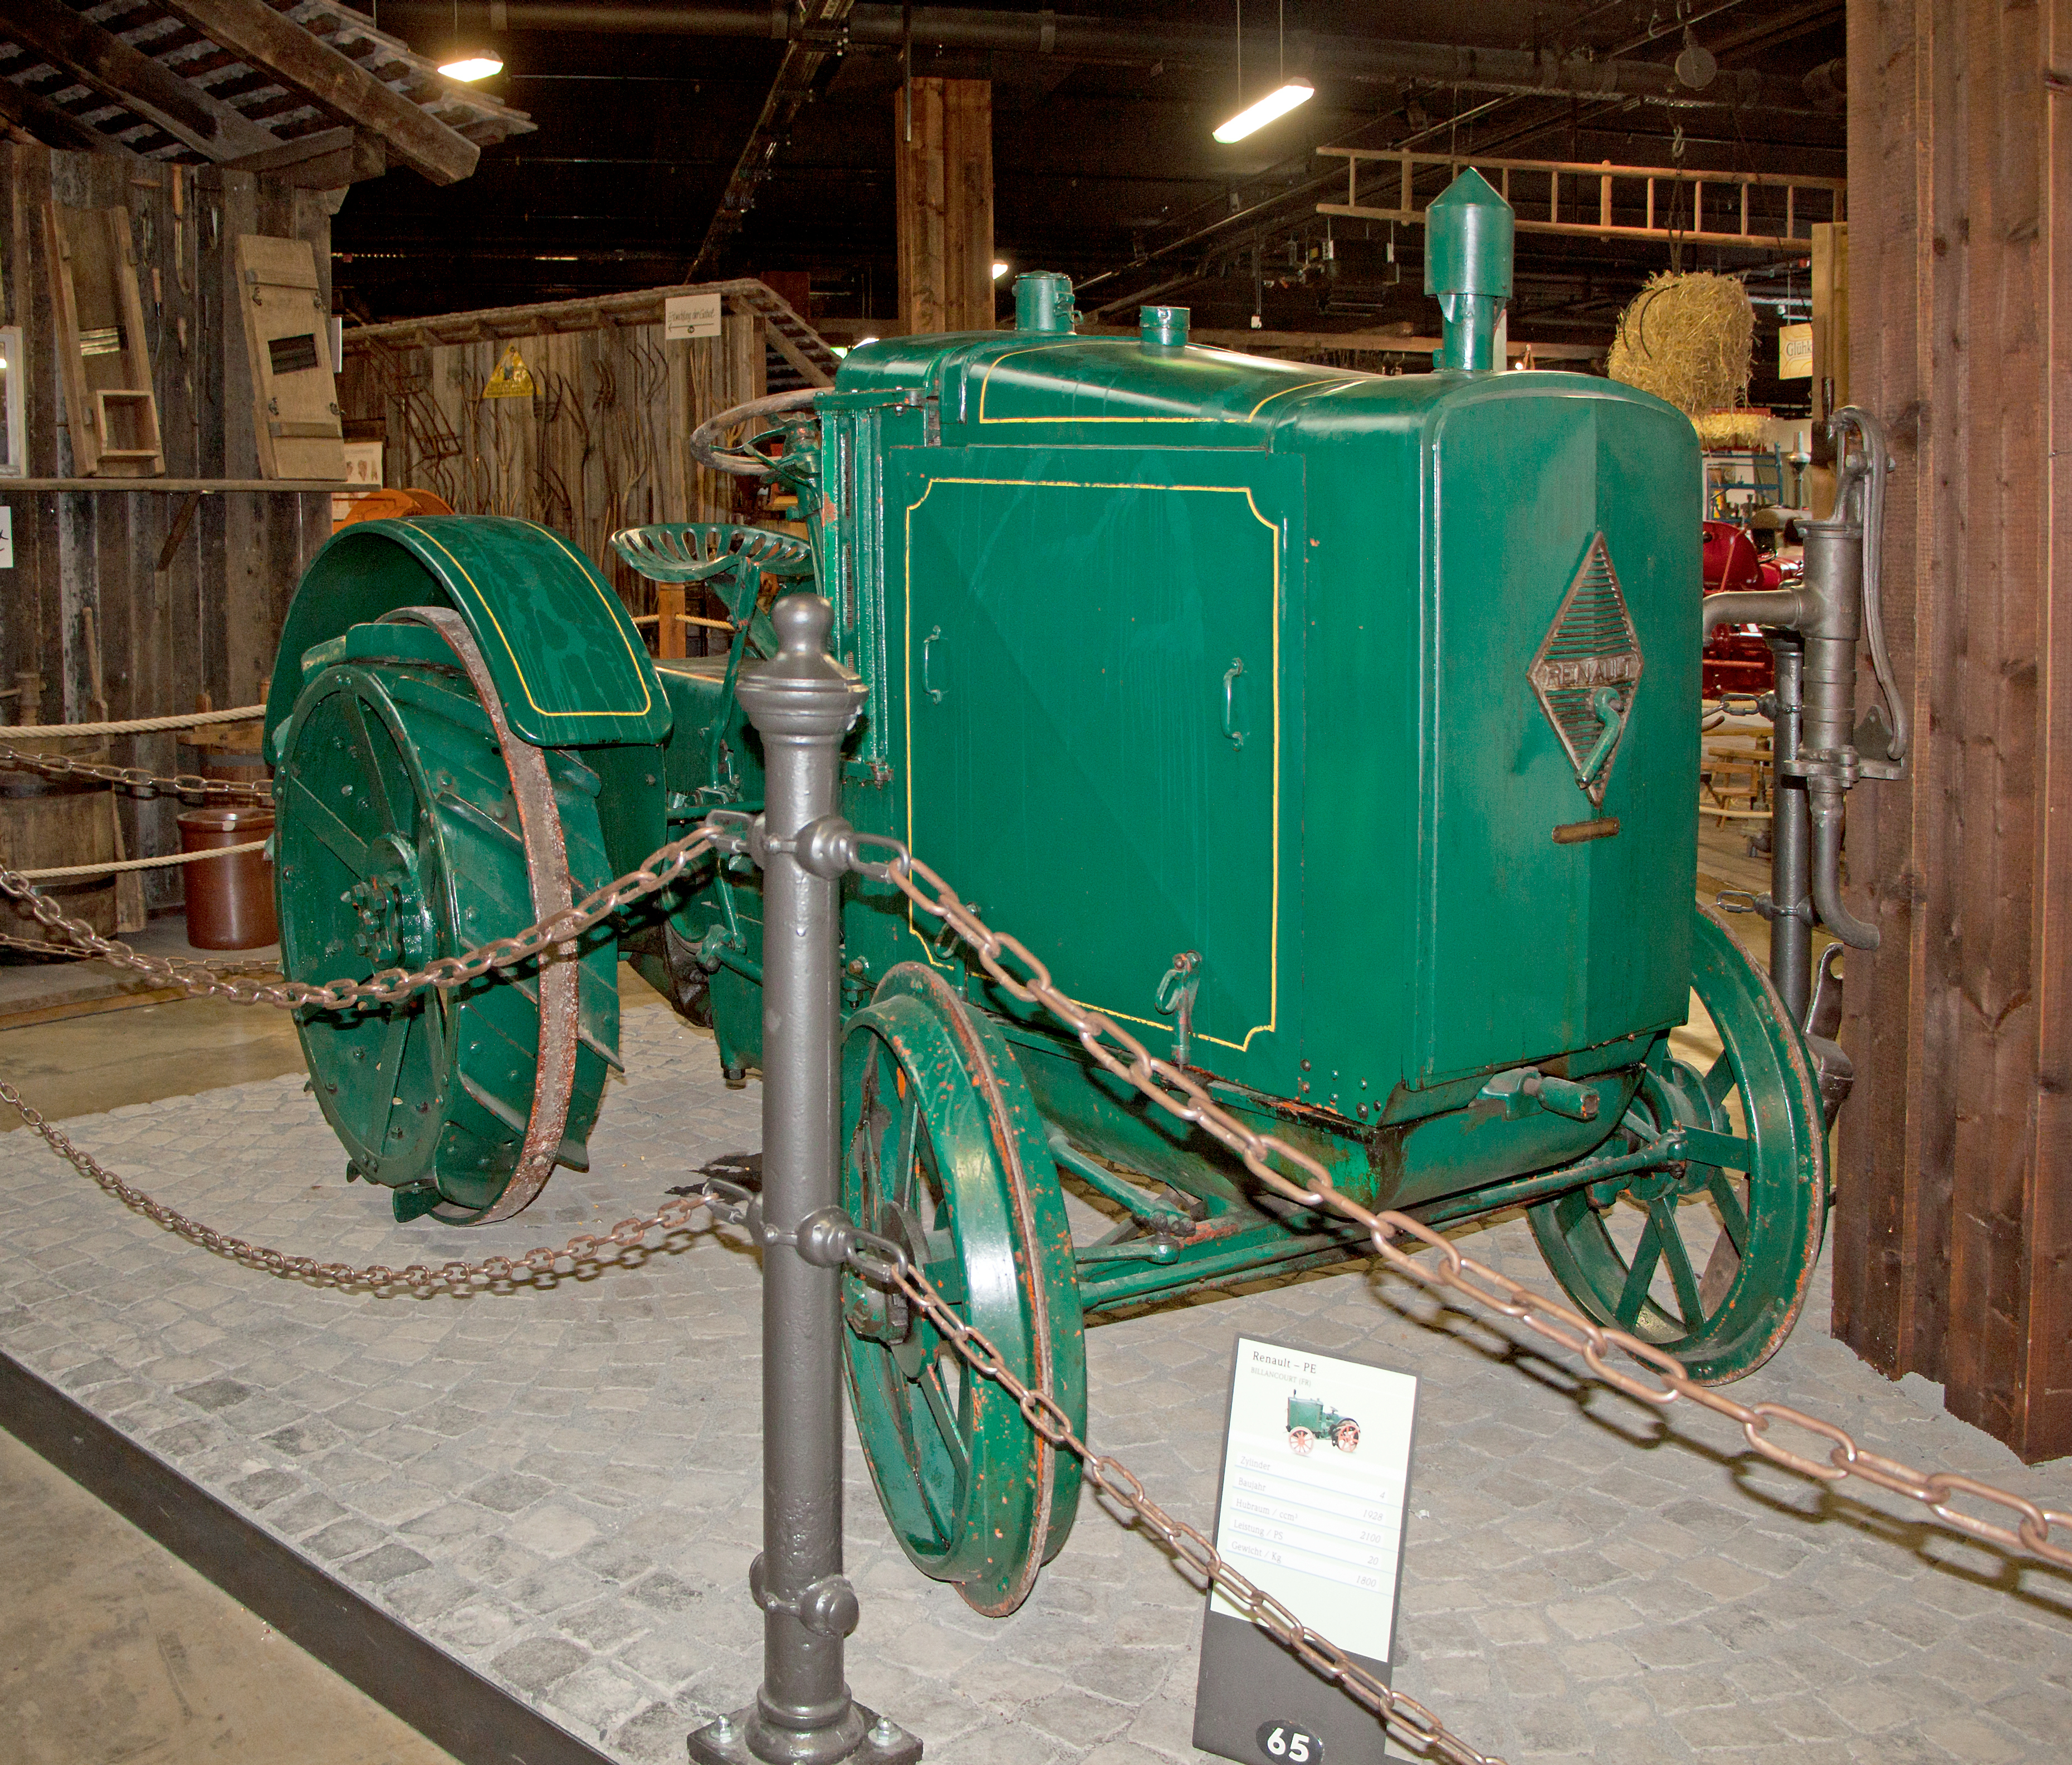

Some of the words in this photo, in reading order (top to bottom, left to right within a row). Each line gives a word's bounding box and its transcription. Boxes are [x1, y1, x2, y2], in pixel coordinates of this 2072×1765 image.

[1545, 655, 1631, 686] RENAULT
[1250, 1367, 1297, 1383] BILLANCOURT
[1298, 1378, 1311, 1387] (FR)
[1253, 1350, 1291, 1368] Renault
[1303, 1362, 1317, 1374] PE
[1240, 1456, 1270, 1471] Zylinder
[1238, 1477, 1266, 1491] Baujahr
[1362, 1509, 1383, 1522] 1928
[1236, 1498, 1270, 1515] Hubraum
[1359, 1531, 1381, 1543] 2100
[1234, 1519, 1265, 1537] Leistung
[1273, 1530, 1283, 1540] PS
[1367, 1556, 1379, 1566] 20
[1231, 1540, 1262, 1557] Gewicht
[1272, 1551, 1281, 1564] Kg
[1356, 1575, 1377, 1587] 1800
[1267, 1727, 1309, 1762] 65
